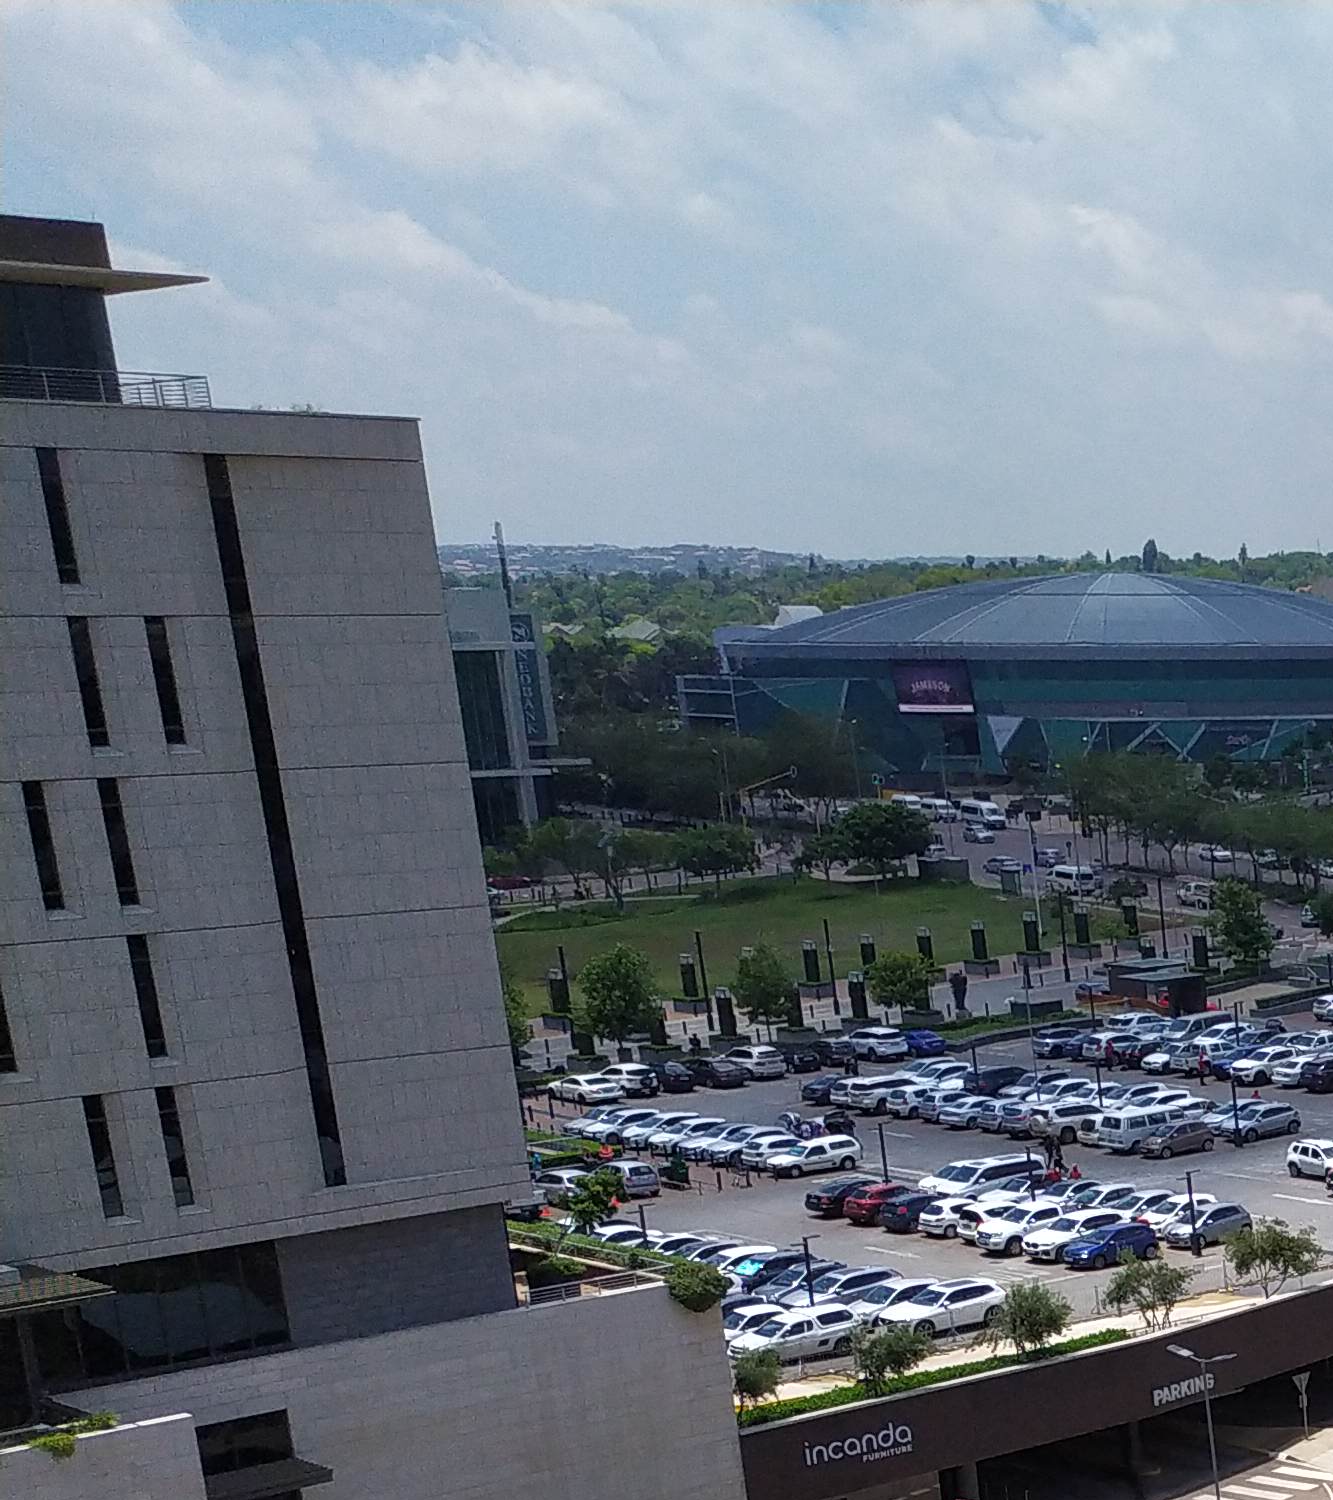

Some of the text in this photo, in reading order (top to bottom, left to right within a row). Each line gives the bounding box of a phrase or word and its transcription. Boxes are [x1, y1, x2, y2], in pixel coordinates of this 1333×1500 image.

[1153, 1373, 1215, 1407] PARKING
[803, 1422, 912, 1466] incanda
[862, 1444, 913, 1463] FURNITURE
